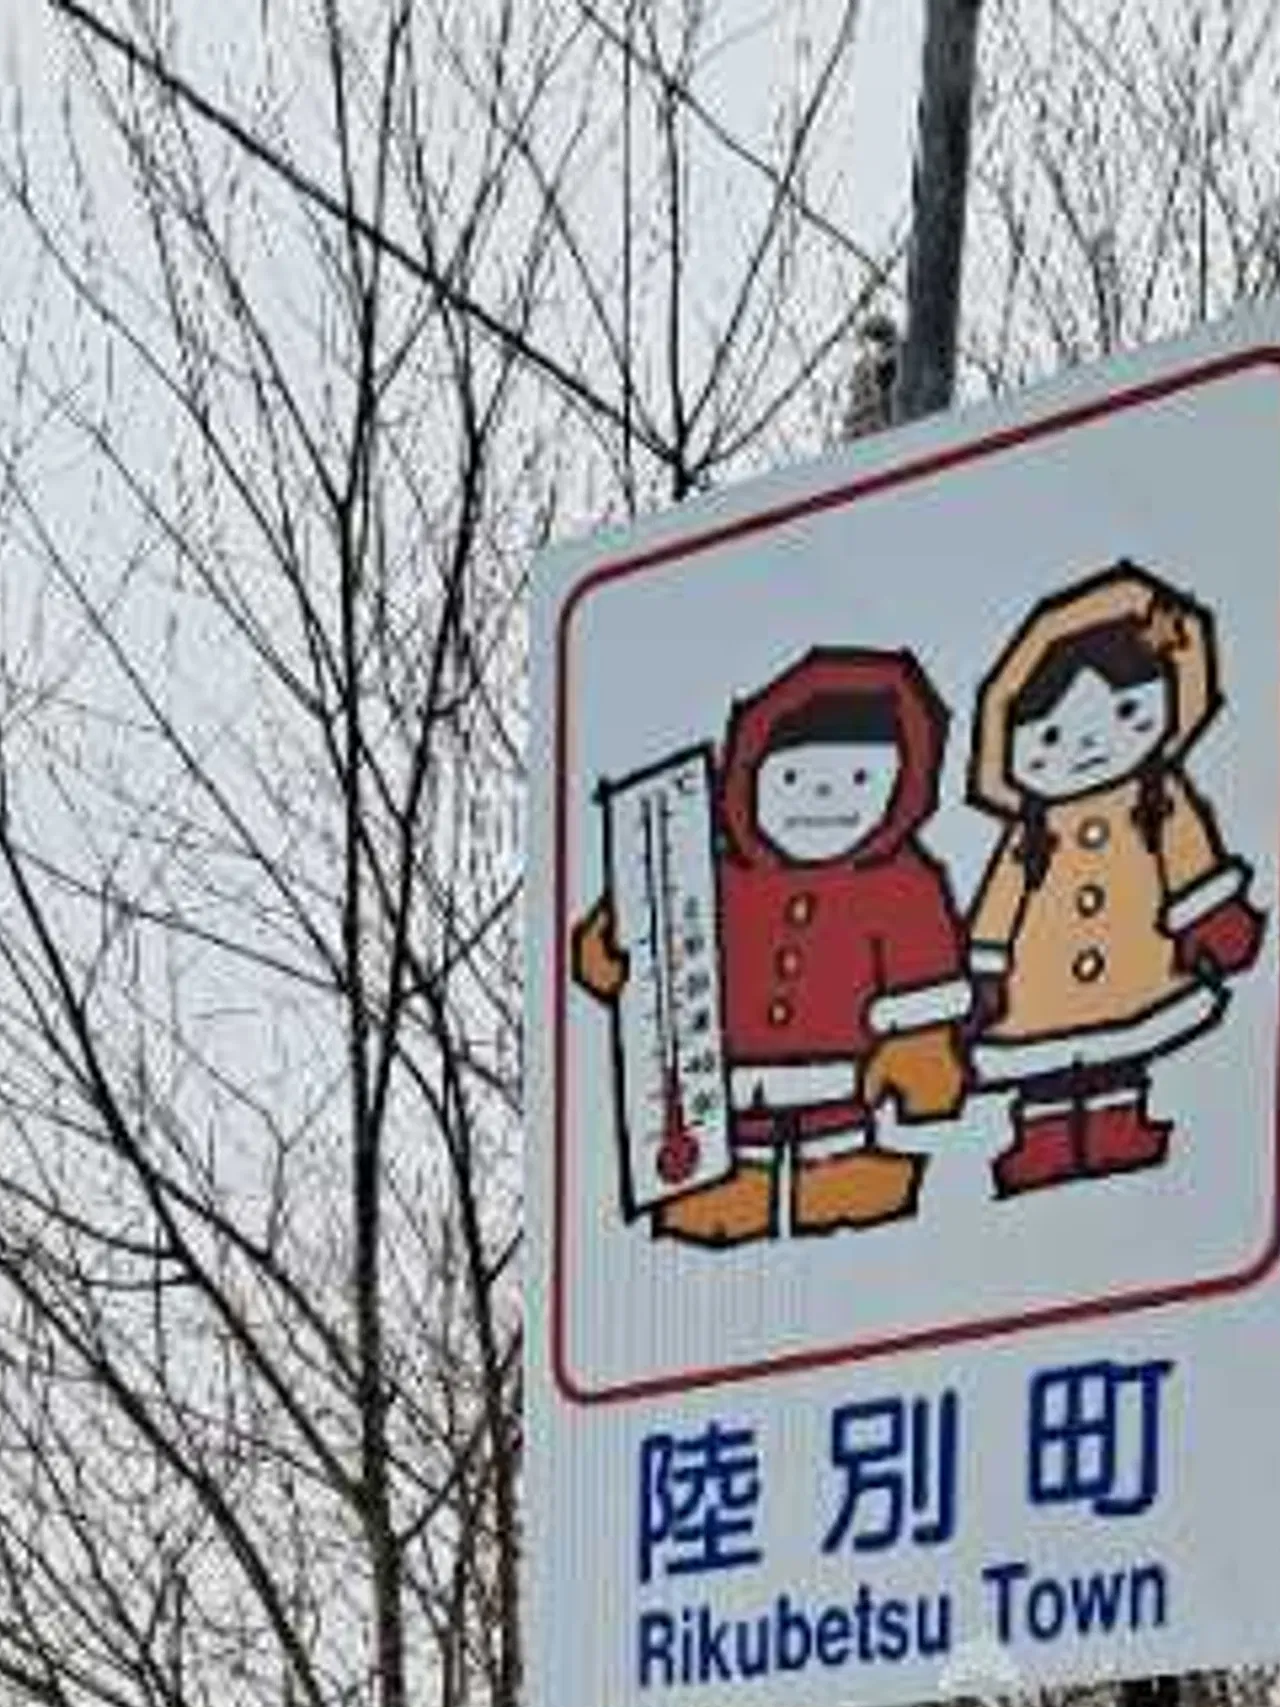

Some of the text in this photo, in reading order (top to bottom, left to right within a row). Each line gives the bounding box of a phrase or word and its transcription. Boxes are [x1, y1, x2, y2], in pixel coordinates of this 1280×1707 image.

[638, 1359, 1176, 1584] 陸別町
[638, 1561, 1167, 1688] Rikubetsu Town
